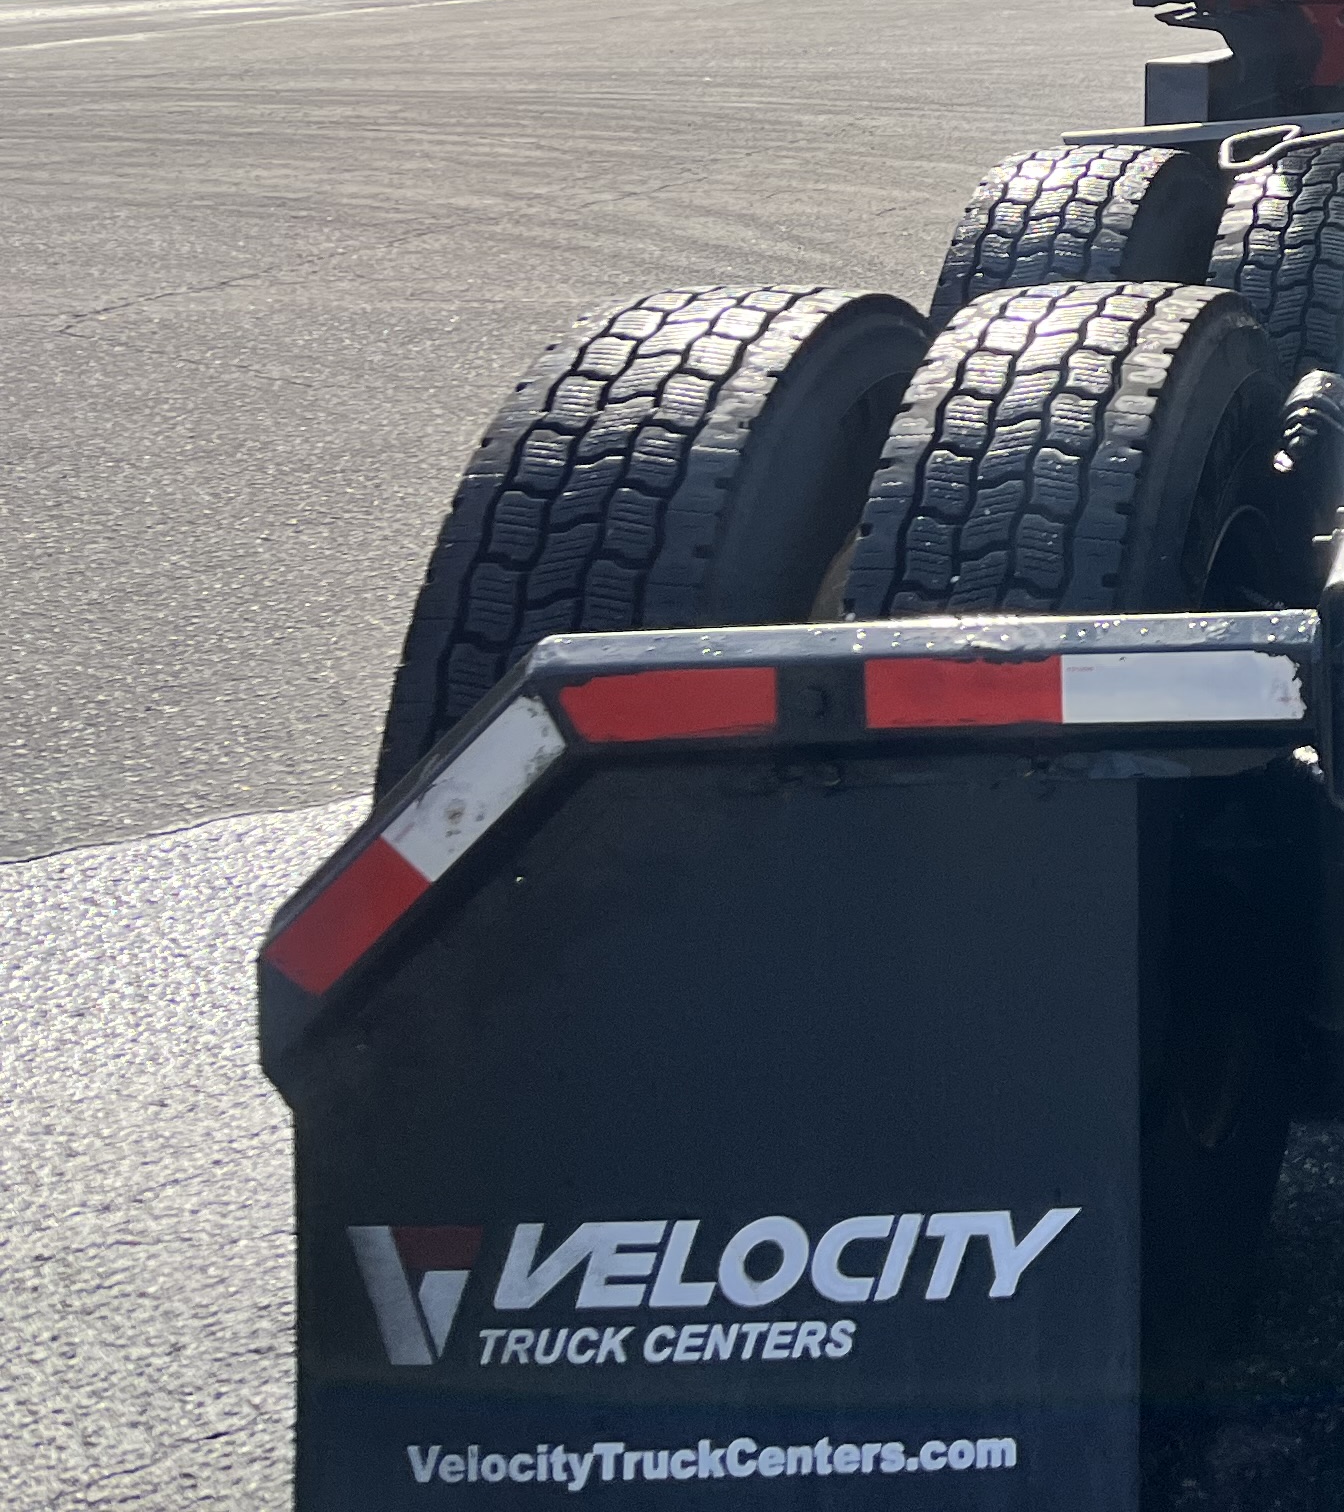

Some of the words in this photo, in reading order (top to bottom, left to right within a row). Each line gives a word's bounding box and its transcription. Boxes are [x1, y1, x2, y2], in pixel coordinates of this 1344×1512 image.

[492, 1206, 1083, 1311] VELOCITY
[479, 1326, 634, 1365] TRUCK
[643, 1319, 857, 1364] CENTERS
[408, 1436, 1017, 1491] VelocityTruckCenters.com
